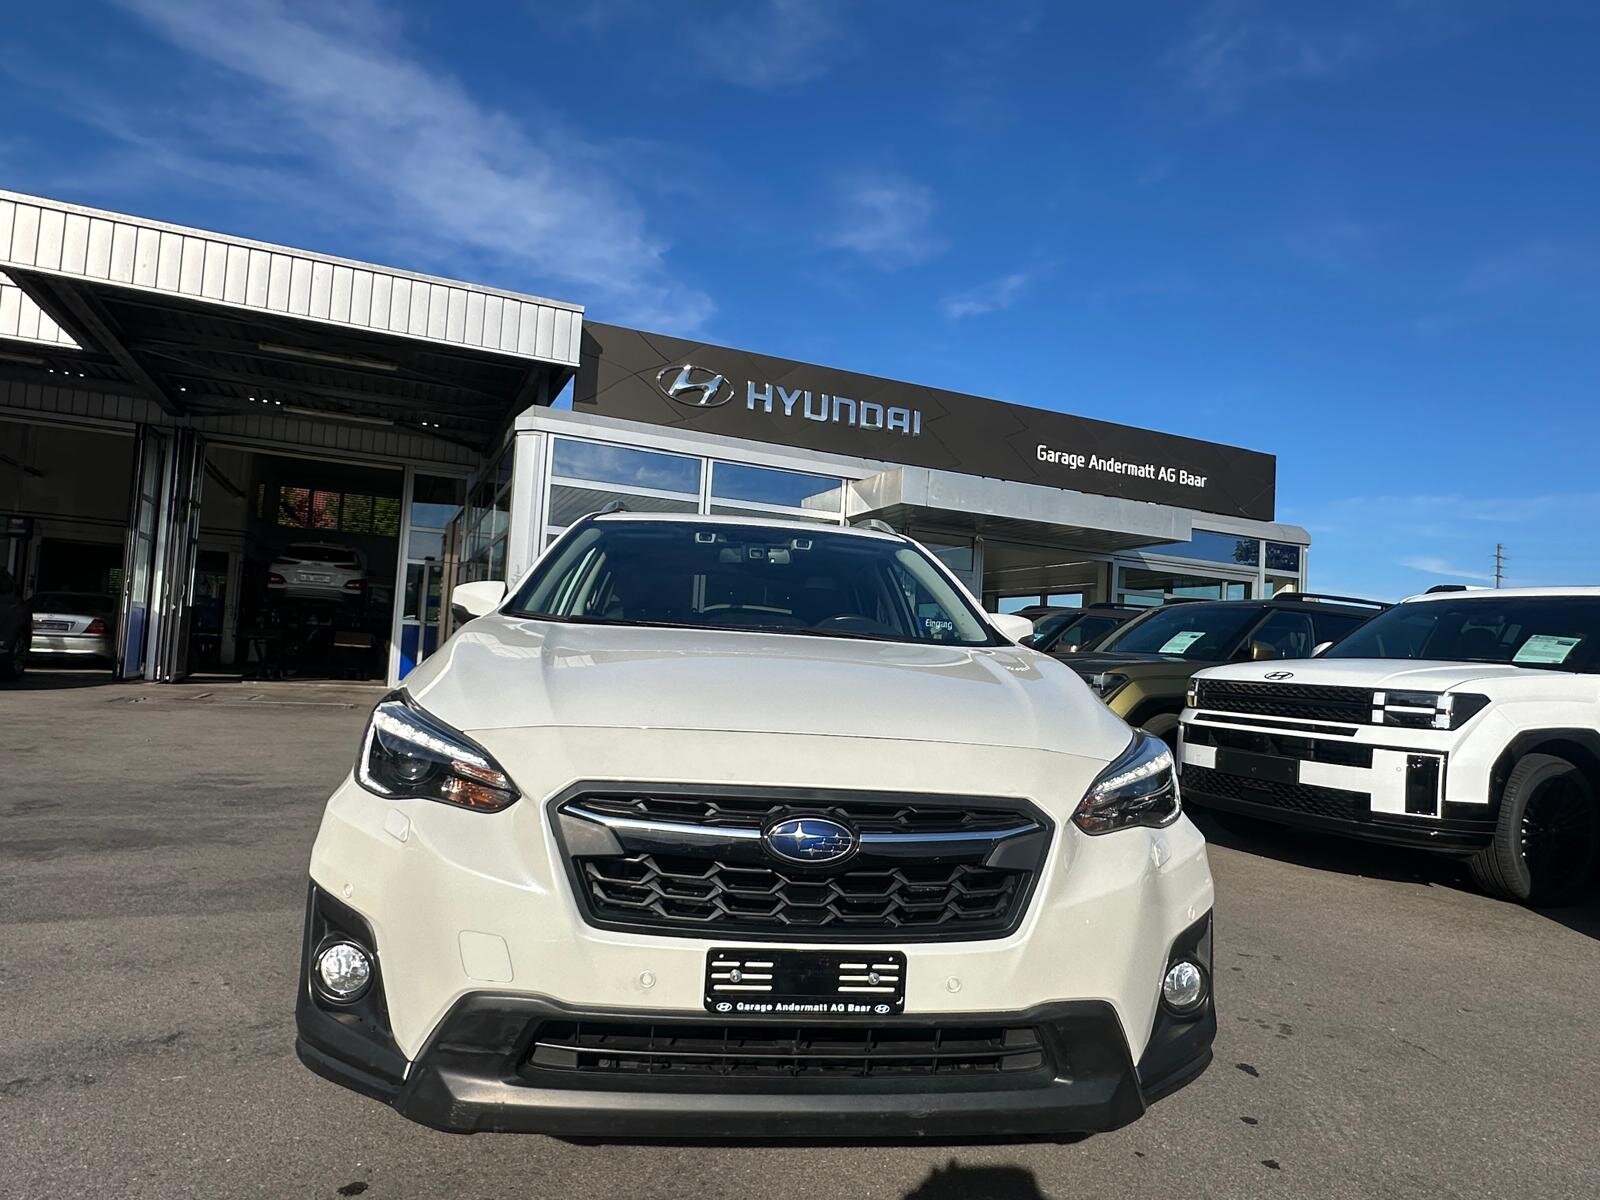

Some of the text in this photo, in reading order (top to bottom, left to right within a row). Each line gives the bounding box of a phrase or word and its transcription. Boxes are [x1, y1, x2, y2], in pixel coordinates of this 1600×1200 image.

[747, 380, 921, 437] HYUNDAI
[1037, 444, 1208, 488] Garage Andermatt AG Baar
[925, 618, 953, 631] Eingang
[736, 1001, 871, 1013] Garage Andermatt AG Baar
